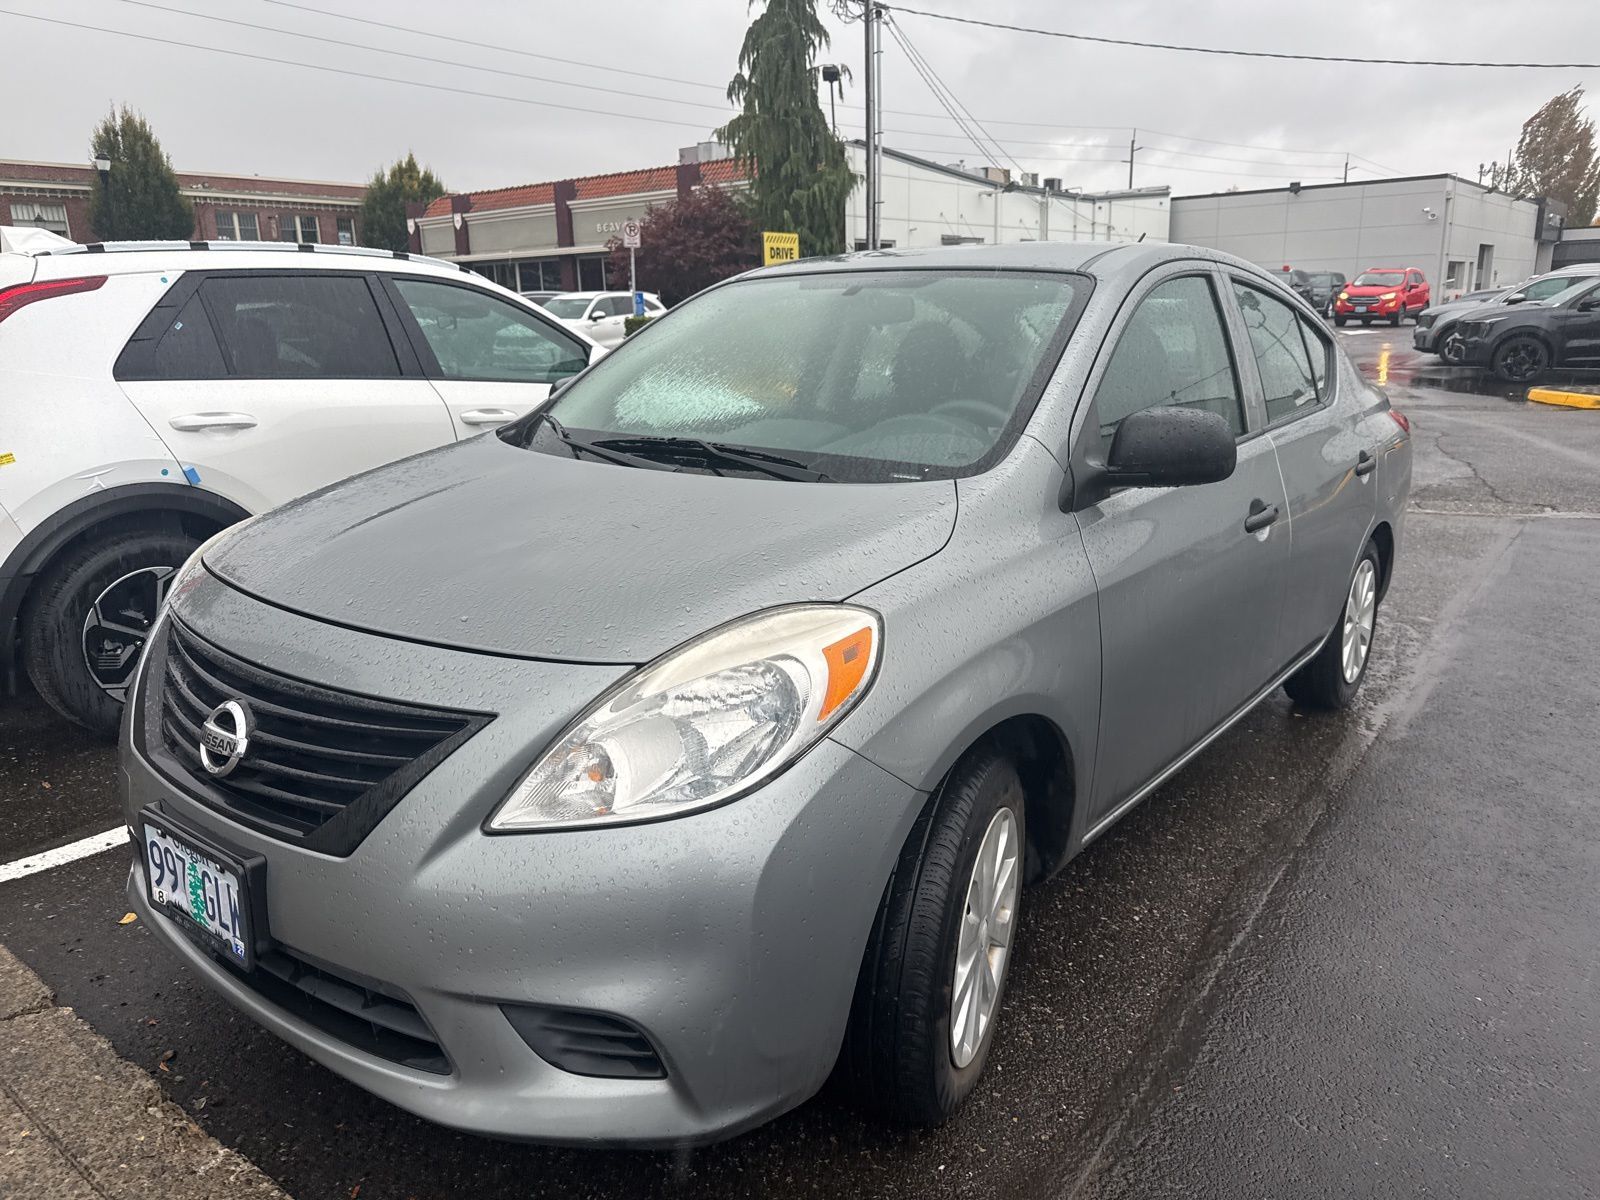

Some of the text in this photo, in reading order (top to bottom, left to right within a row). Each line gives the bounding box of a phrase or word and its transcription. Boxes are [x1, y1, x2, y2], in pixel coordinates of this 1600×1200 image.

[770, 247, 794, 260] DRIVE
[149, 840, 187, 895] 997
[158, 890, 165, 904] 8
